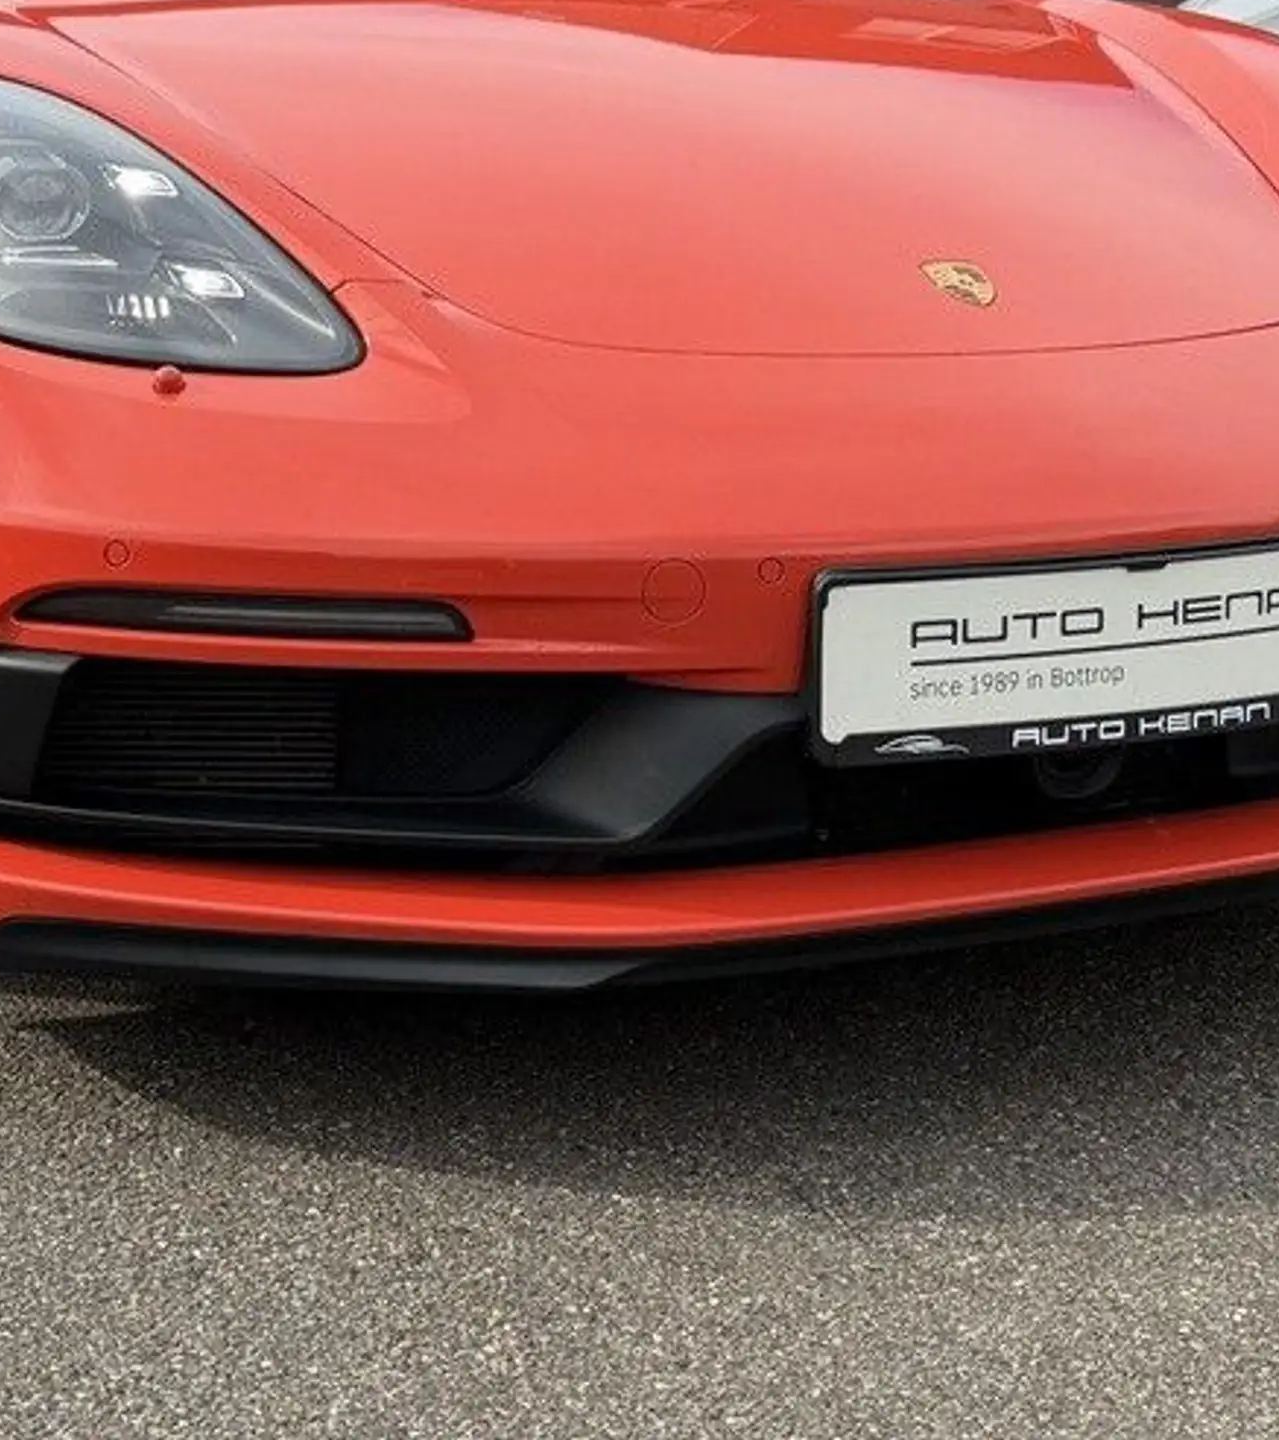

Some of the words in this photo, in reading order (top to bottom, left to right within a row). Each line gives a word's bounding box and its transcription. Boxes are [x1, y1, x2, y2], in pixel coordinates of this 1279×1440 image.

[911, 606, 1105, 650] AUTO
[909, 675, 963, 701] since
[969, 670, 1020, 697] 1989
[1026, 669, 1044, 691] in
[1050, 663, 1125, 693] Bottrop
[1011, 718, 1125, 749] AUTO
